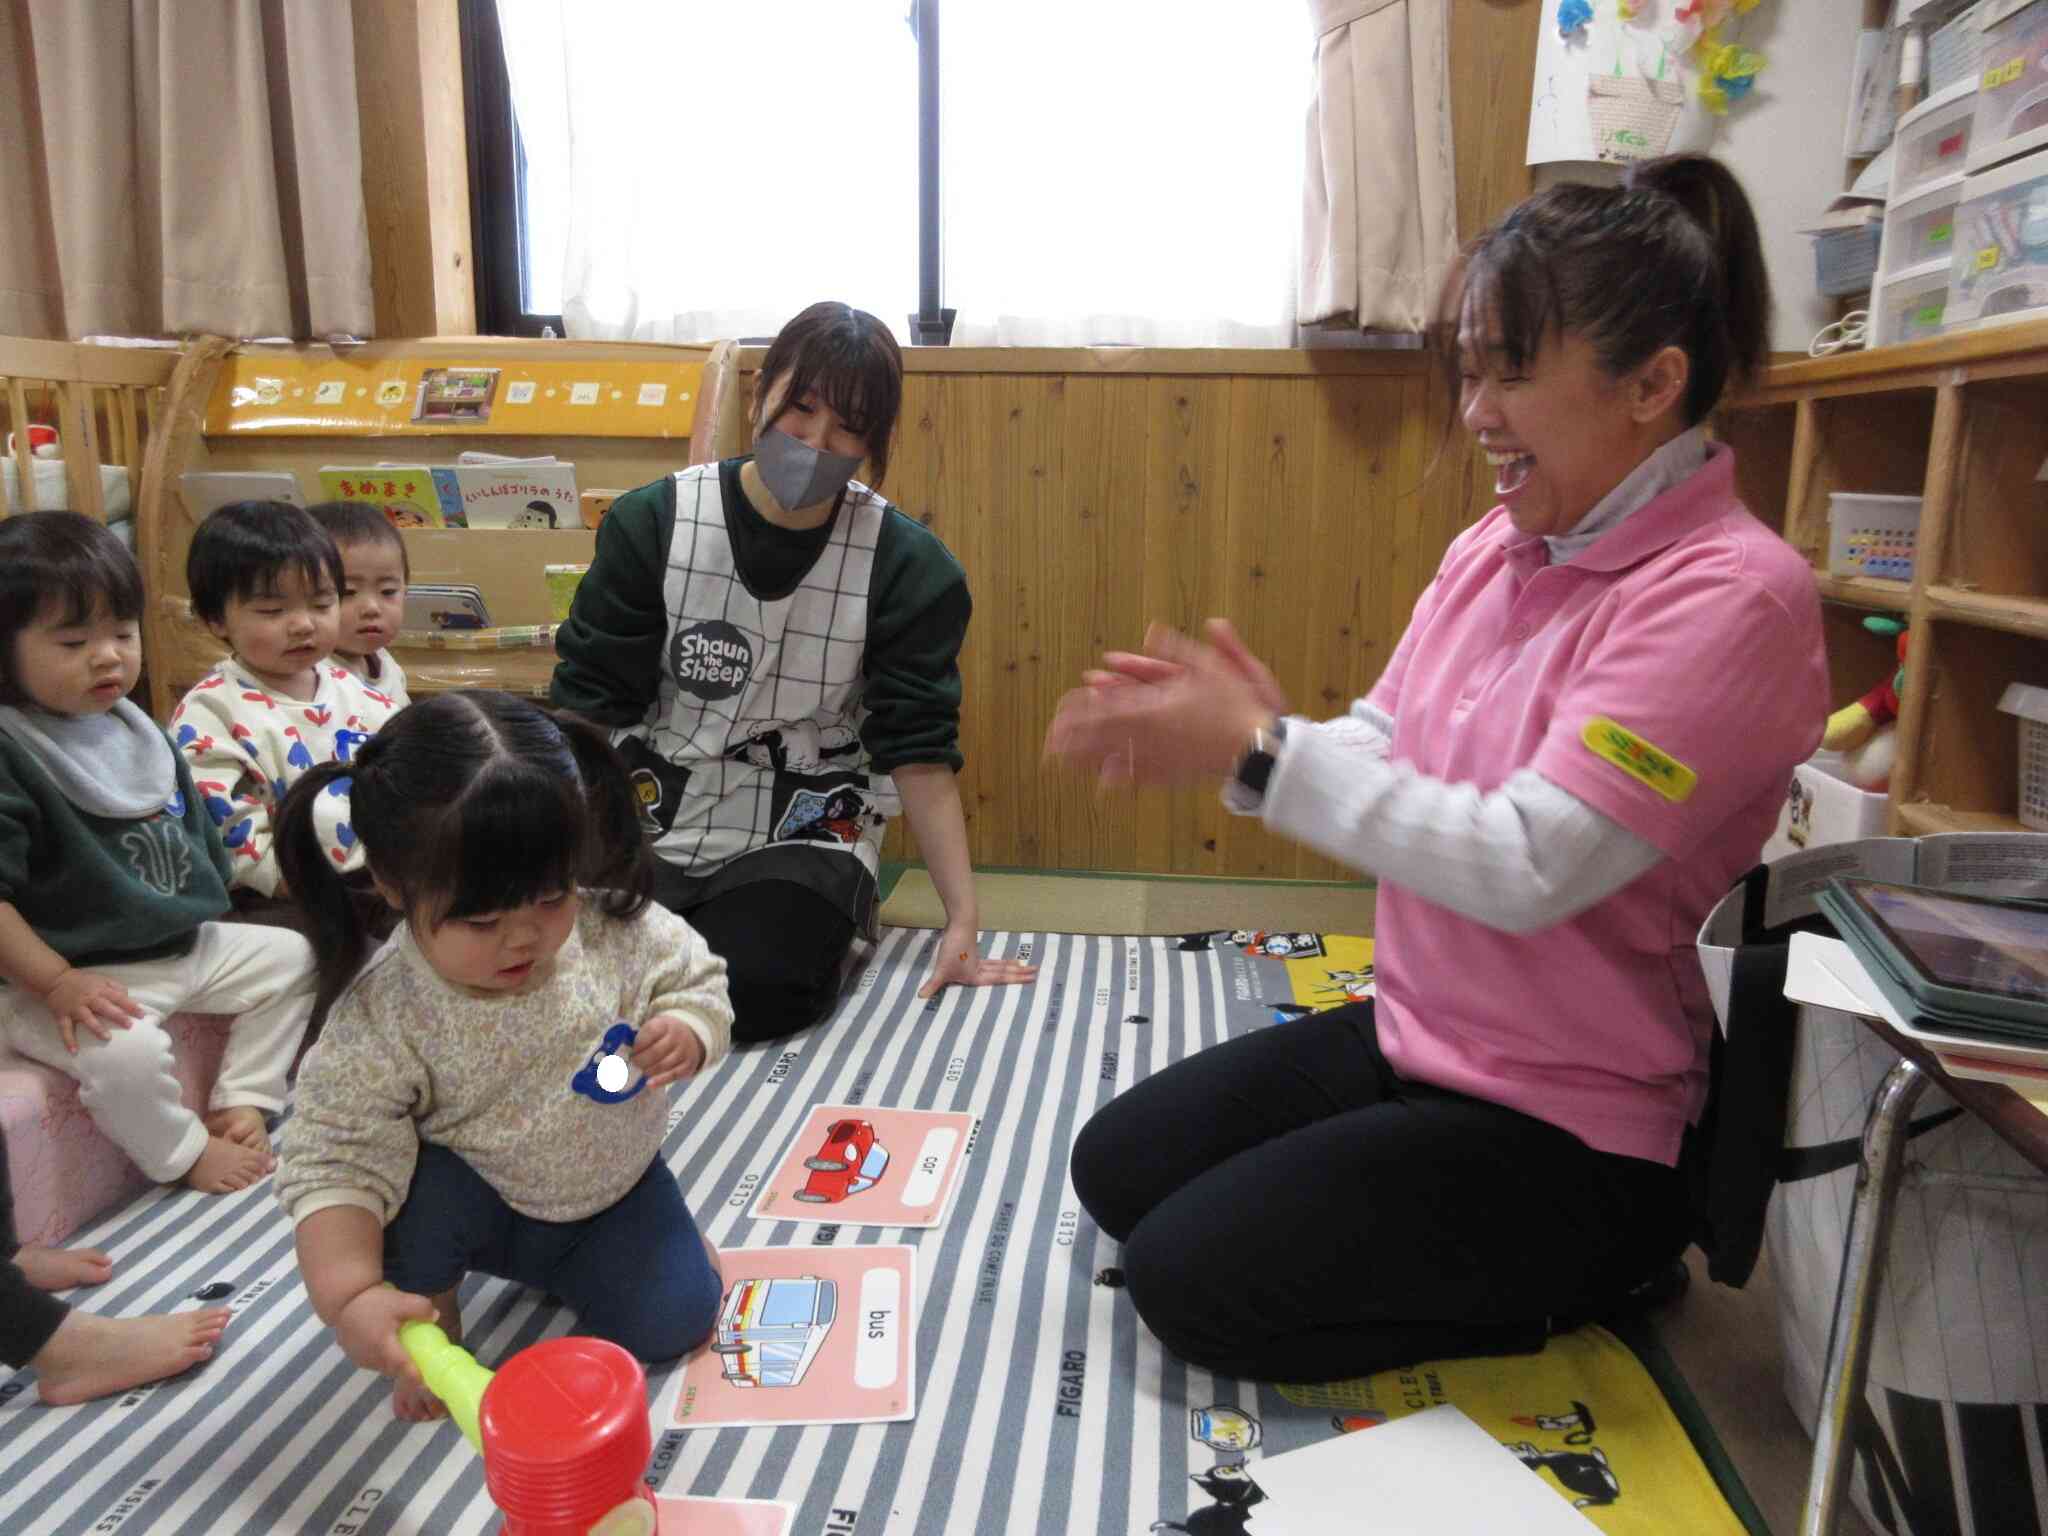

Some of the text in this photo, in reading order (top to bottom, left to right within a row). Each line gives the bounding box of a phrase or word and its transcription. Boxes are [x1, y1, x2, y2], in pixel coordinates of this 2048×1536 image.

[681, 632, 749, 663] Shaun
[704, 654, 722, 667] the
[680, 658, 743, 687] Sheep
[767, 1053, 798, 1083] FIGARO
[946, 1057, 964, 1082] CLEO
[921, 1156, 938, 1175] car
[729, 1174, 759, 1206] CLEO
[1056, 1211, 1077, 1246] CLEO
[868, 1310, 891, 1339] bus
[1057, 1350, 1086, 1417] FIGARO
[97, 1480, 162, 1531] WISHES
